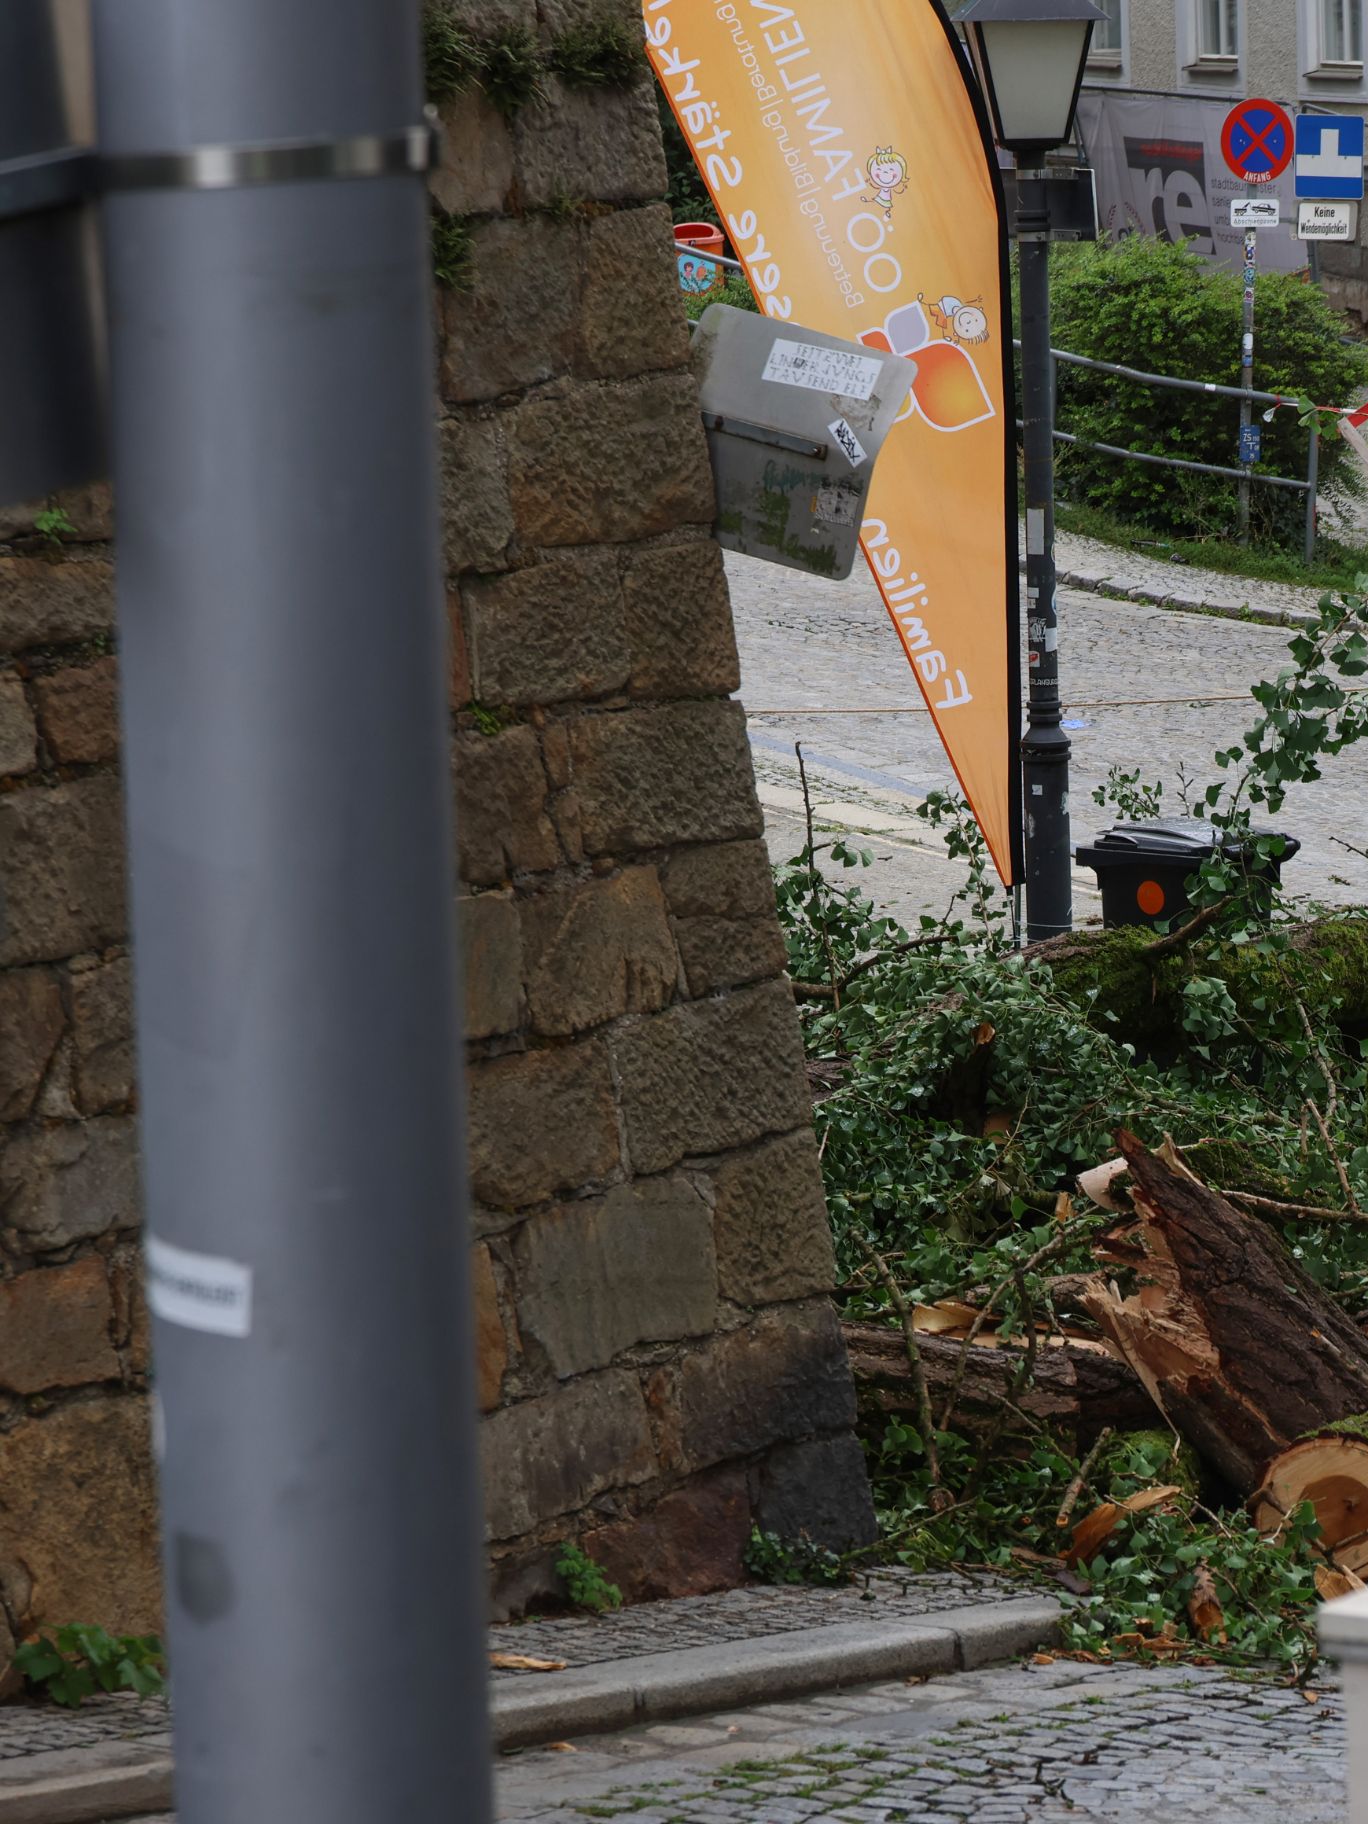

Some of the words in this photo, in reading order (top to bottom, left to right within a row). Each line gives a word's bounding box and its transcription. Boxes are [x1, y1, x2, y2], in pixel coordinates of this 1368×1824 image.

[1243, 171, 1272, 183] ANFANG
[1314, 206, 1335, 218] Keine
[1301, 222, 1347, 236] Wendemöglichkeit
